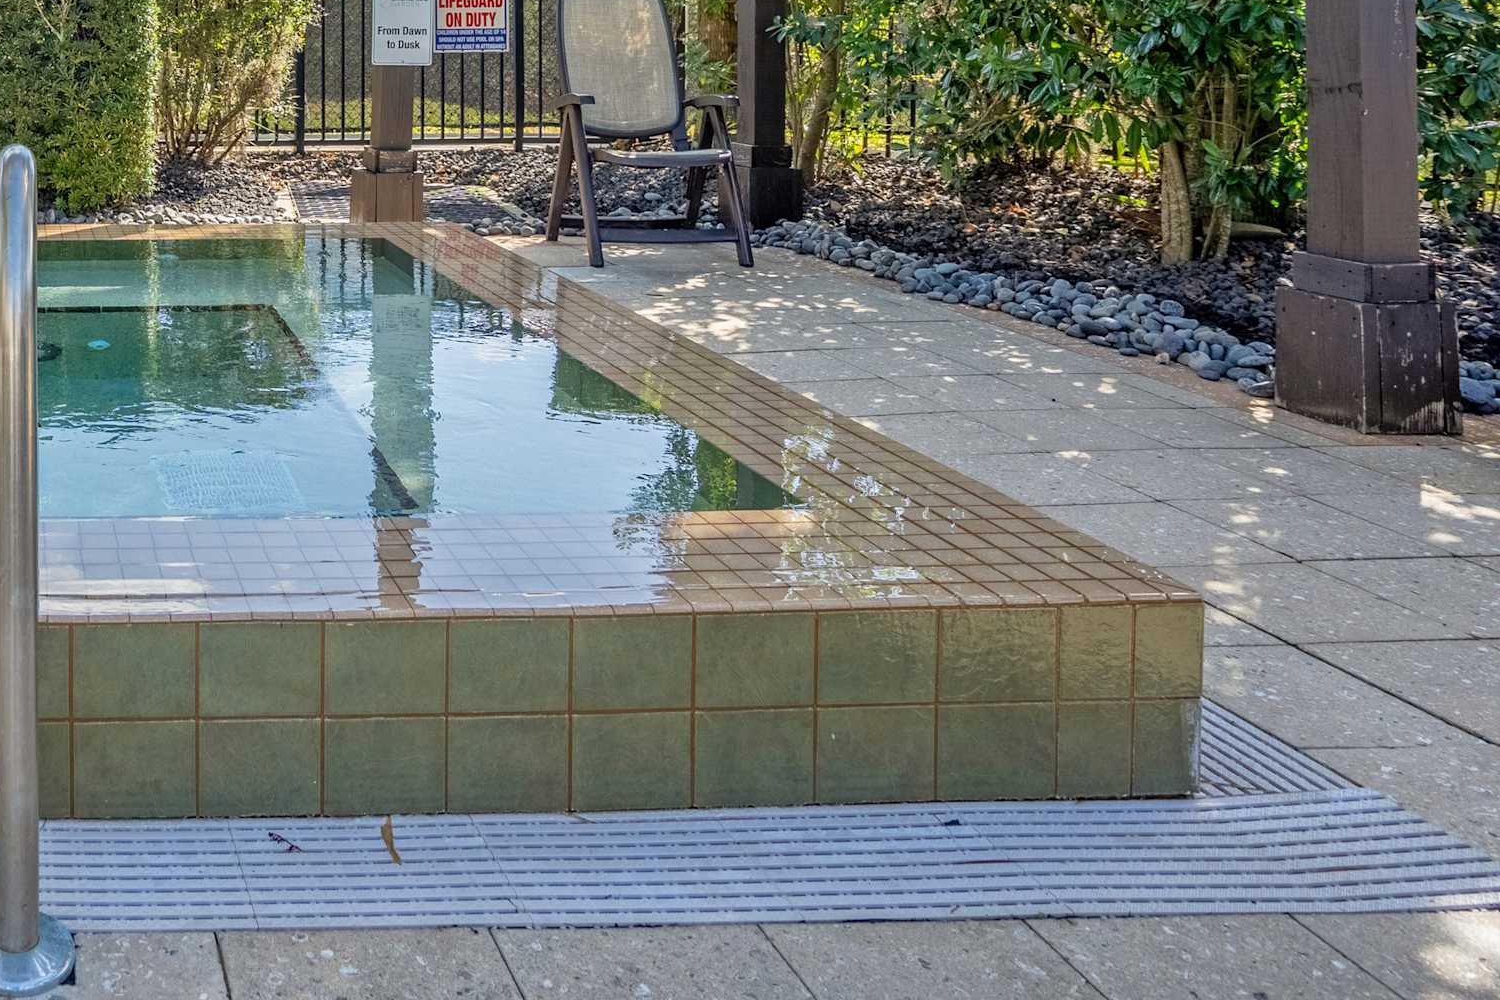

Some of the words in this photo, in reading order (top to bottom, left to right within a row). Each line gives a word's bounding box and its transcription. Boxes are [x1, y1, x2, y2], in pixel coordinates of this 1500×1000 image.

[446, 12, 462, 27] ON
[466, 12, 496, 27] DUTY
[377, 26, 400, 35] From
[403, 26, 427, 35] Dawn
[387, 40, 396, 48] to
[398, 40, 420, 48] Dusk
